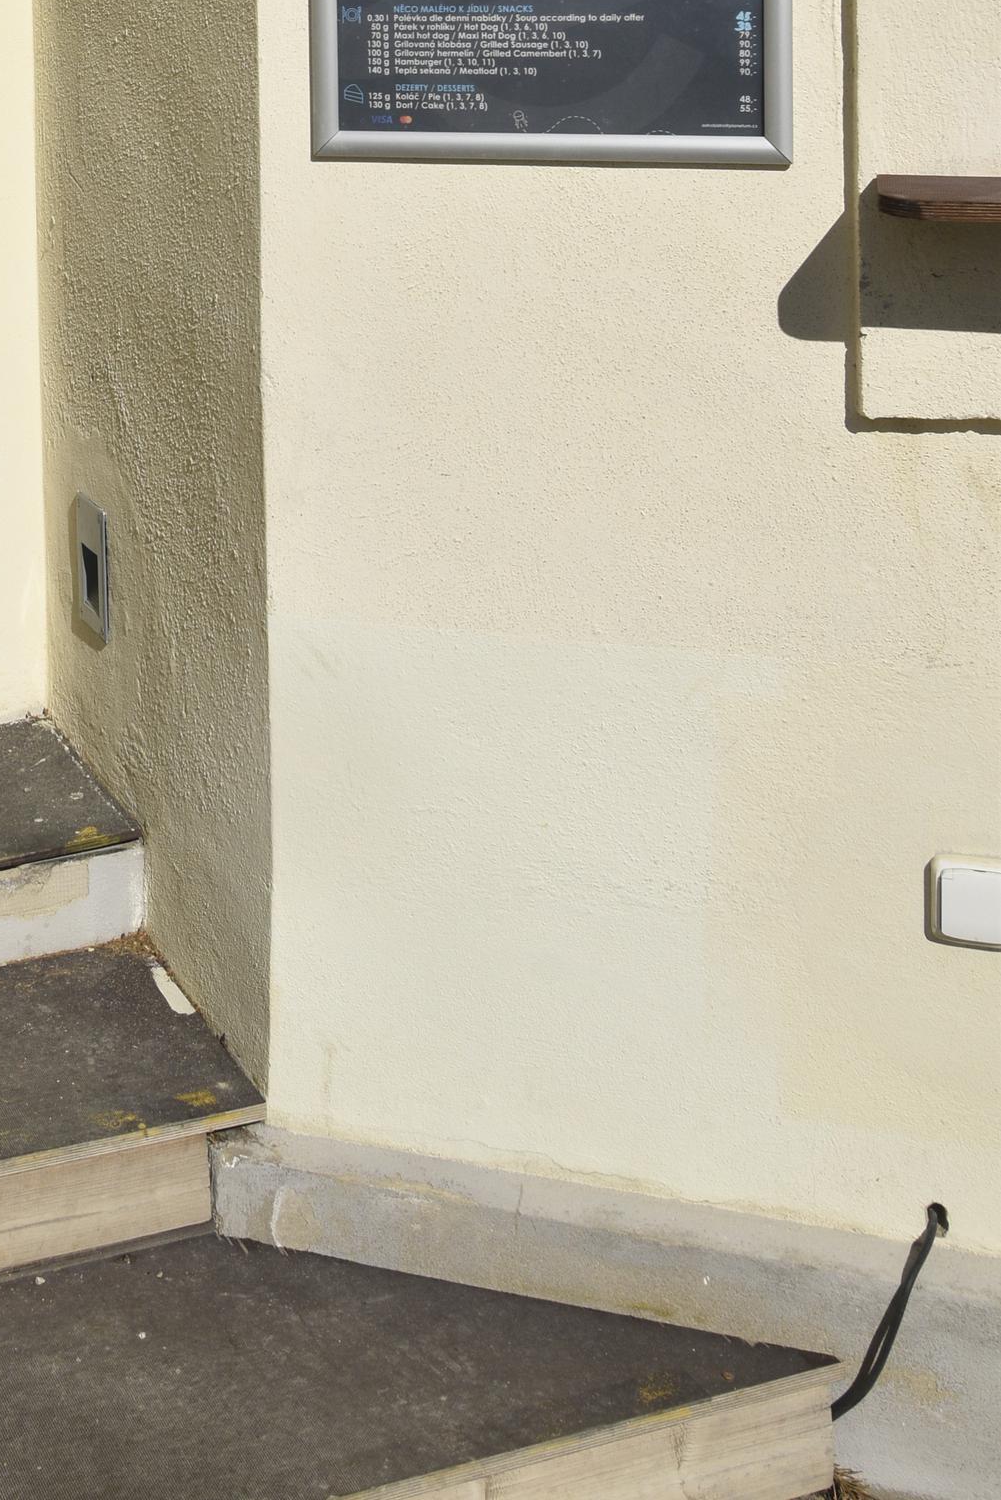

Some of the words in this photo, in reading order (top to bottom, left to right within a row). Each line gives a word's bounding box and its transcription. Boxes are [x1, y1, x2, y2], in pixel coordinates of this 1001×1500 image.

[393, 3, 418, 12] NĚCO
[420, 2, 456, 12] MALÉHO
[466, 2, 488, 11] JÍDLU
[394, 49, 434, 58] Grilovaný
[394, 58, 441, 67] Hamburger
[395, 66, 417, 75] Teplá
[371, 115, 392, 124] VISA
